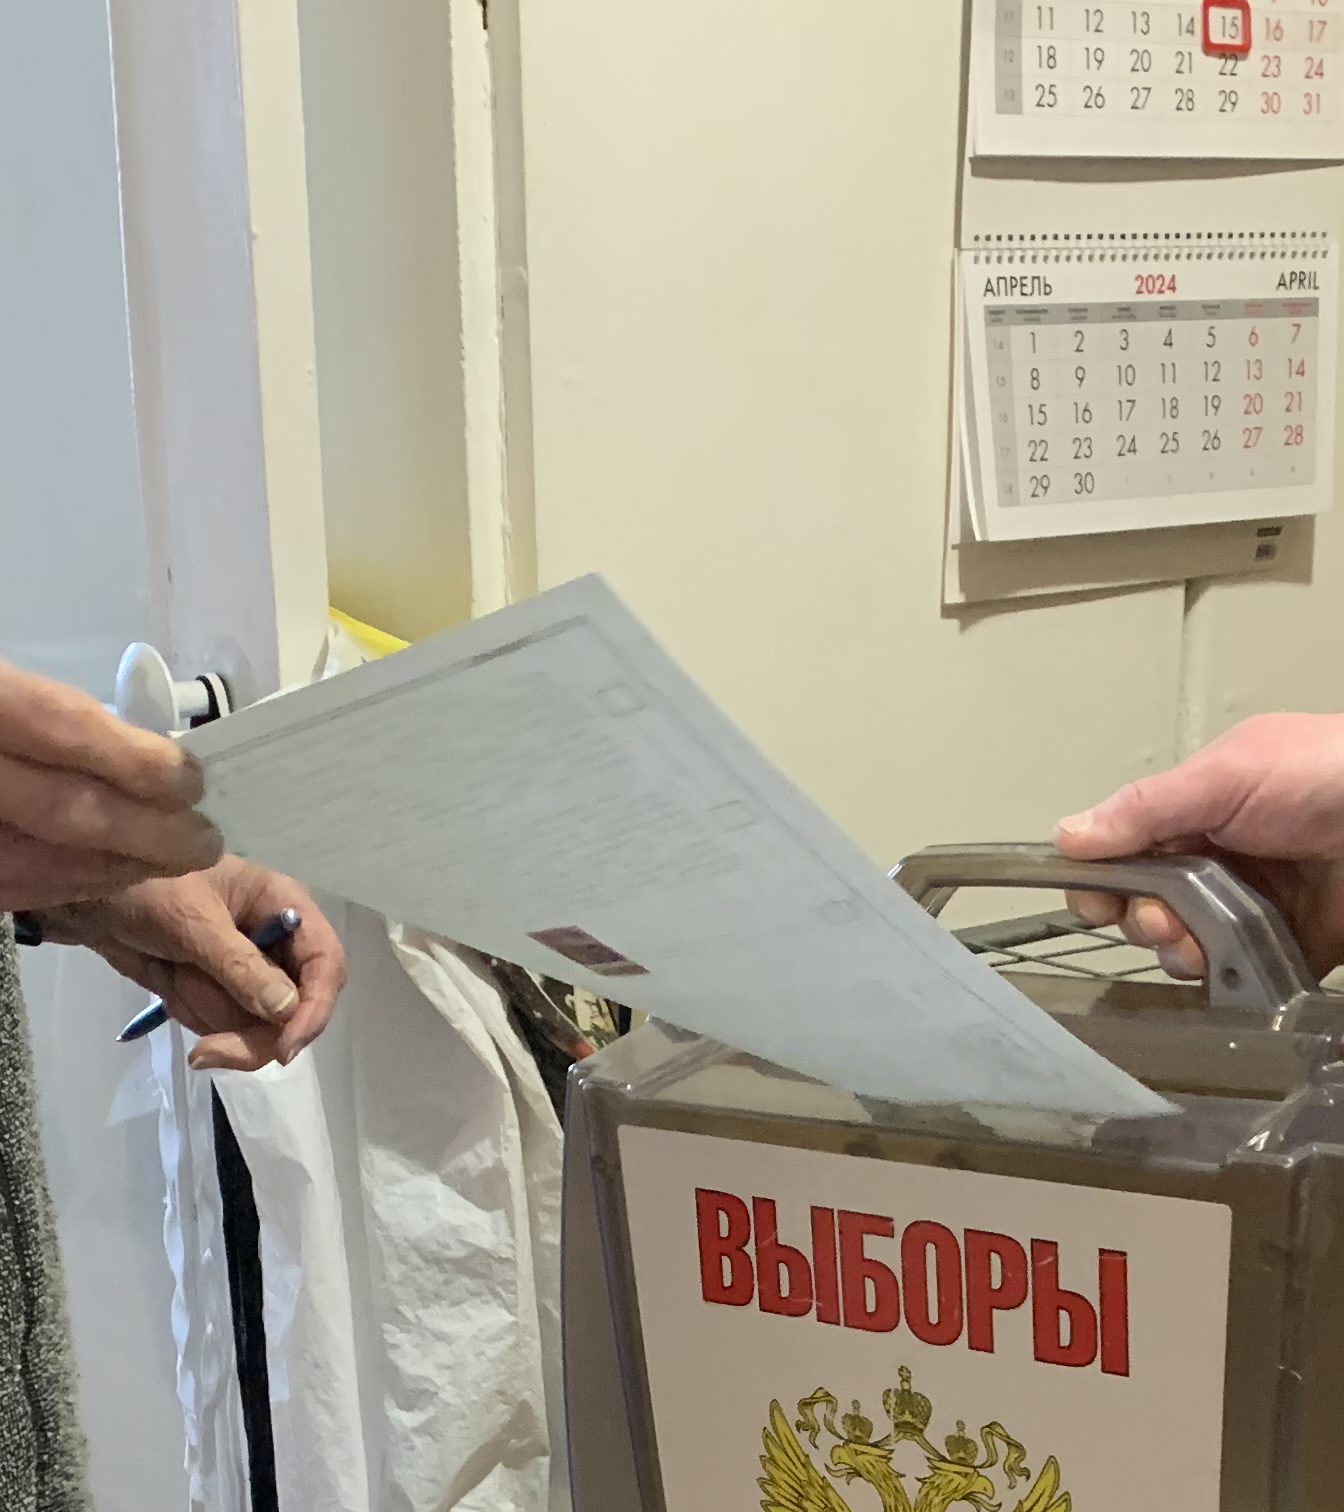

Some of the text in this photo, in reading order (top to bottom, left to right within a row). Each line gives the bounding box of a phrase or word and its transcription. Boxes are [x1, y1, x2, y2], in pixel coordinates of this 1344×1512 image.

[1037, 6, 1054, 30] 11
[1085, 9, 1104, 33] 12
[1131, 11, 1150, 35] 13
[1177, 13, 1195, 36] 14
[1221, 16, 1239, 39] 15
[1265, 18, 1284, 41] 16
[1309, 20, 1327, 43] 17
[1037, 45, 1057, 69] 18
[1085, 47, 1105, 71] 19
[1130, 49, 1152, 72] 20
[1175, 51, 1192, 74] 21
[1218, 53, 1238, 76] 22
[1261, 55, 1281, 78] 23
[1304, 57, 1325, 79] 24
[1035, 84, 1057, 108] 25
[1083, 85, 1105, 109] 26
[1130, 87, 1152, 110] 27
[1175, 88, 1195, 111] 28
[1218, 90, 1238, 112] 29
[1261, 92, 1281, 114] 30
[1303, 93, 1321, 114] 31
[983, 271, 1320, 297] АПРЕЛЬ 2024 APRIL
[1030, 332, 1036, 354] 1
[1074, 330, 1085, 352] 2
[1120, 329, 1129, 351] 3
[1163, 328, 1174, 349] 4
[1206, 326, 1216, 348] 5
[1248, 326, 1259, 347] 6
[1291, 323, 1302, 344] 7
[1030, 367, 1040, 390] 8
[1075, 366, 1086, 388] 9
[1117, 364, 1136, 386] 10
[1160, 363, 1176, 384] 11
[1203, 361, 1221, 382] 12
[1246, 359, 1263, 380] 13
[1288, 357, 1305, 378] 14
[1028, 404, 1047, 426] 15
[1073, 402, 1093, 424] 16
[1117, 399, 1136, 421] 17
[1161, 397, 1179, 419] 18
[1204, 395, 1221, 416] 19
[1243, 393, 1263, 415] 20
[1284, 391, 1302, 413] 21
[1028, 439, 1049, 462] 22
[1072, 437, 1093, 459] 23
[1116, 434, 1137, 457] 24
[1159, 432, 1180, 454] 25
[1202, 429, 1221, 451] 26
[1242, 427, 1263, 448] 27
[1284, 424, 1304, 446] 28
[1030, 475, 1050, 497] 29
[1074, 472, 1095, 494] 30
[695, 1187, 1130, 1377] ВЫБОРЫ
